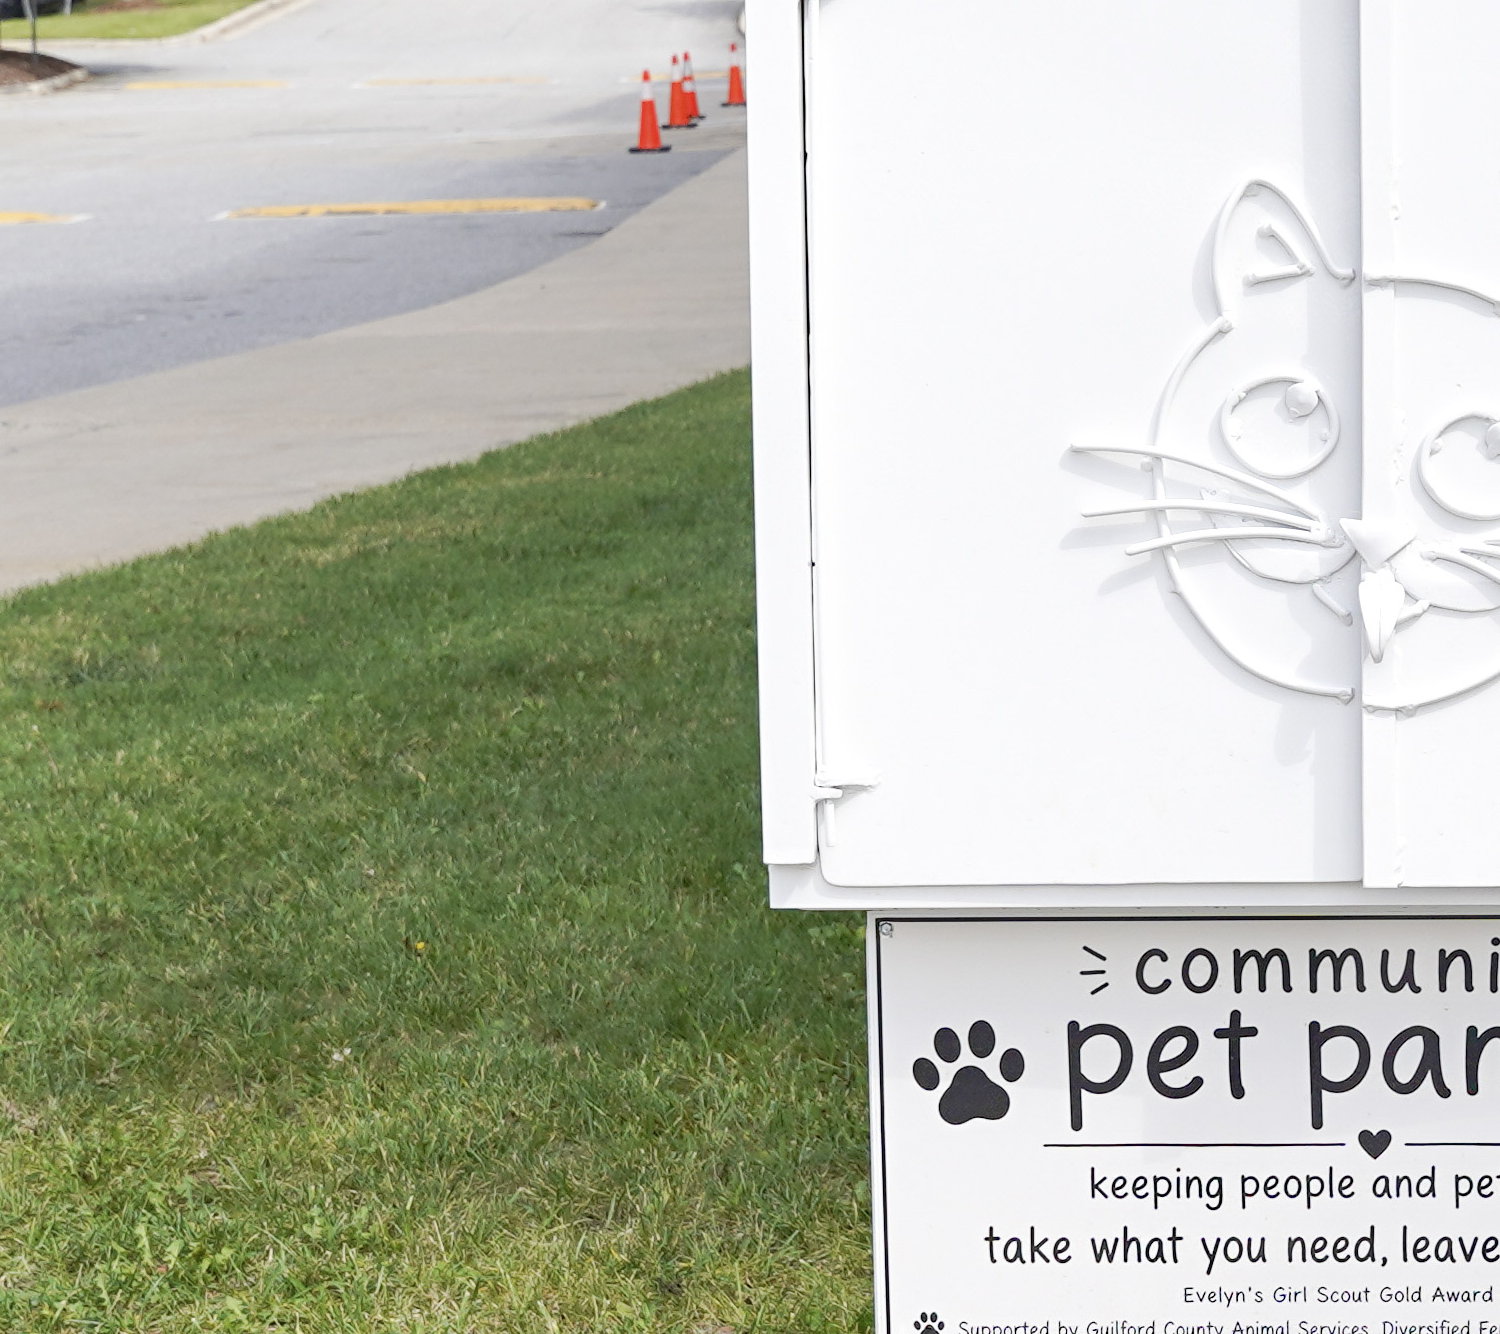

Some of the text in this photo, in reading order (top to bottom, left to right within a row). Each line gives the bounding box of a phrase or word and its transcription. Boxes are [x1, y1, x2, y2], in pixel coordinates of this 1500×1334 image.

[1067, 1009, 1259, 1132] pet
[1090, 1166, 1224, 1211] keeping
[1240, 1165, 1355, 1210] people
[1372, 1165, 1437, 1200] and
[984, 1225, 1072, 1265] take
[1090, 1225, 1184, 1264] what
[1200, 1236, 1267, 1274] you
[1287, 1224, 1388, 1267] need,
[1402, 1225, 1500, 1264] leave
[1184, 1286, 1264, 1308] Evelyn's
[1273, 1286, 1307, 1303] Girl
[1317, 1286, 1371, 1304] Scout
[1379, 1286, 1422, 1303] Gold
[1432, 1286, 1493, 1303] Award
